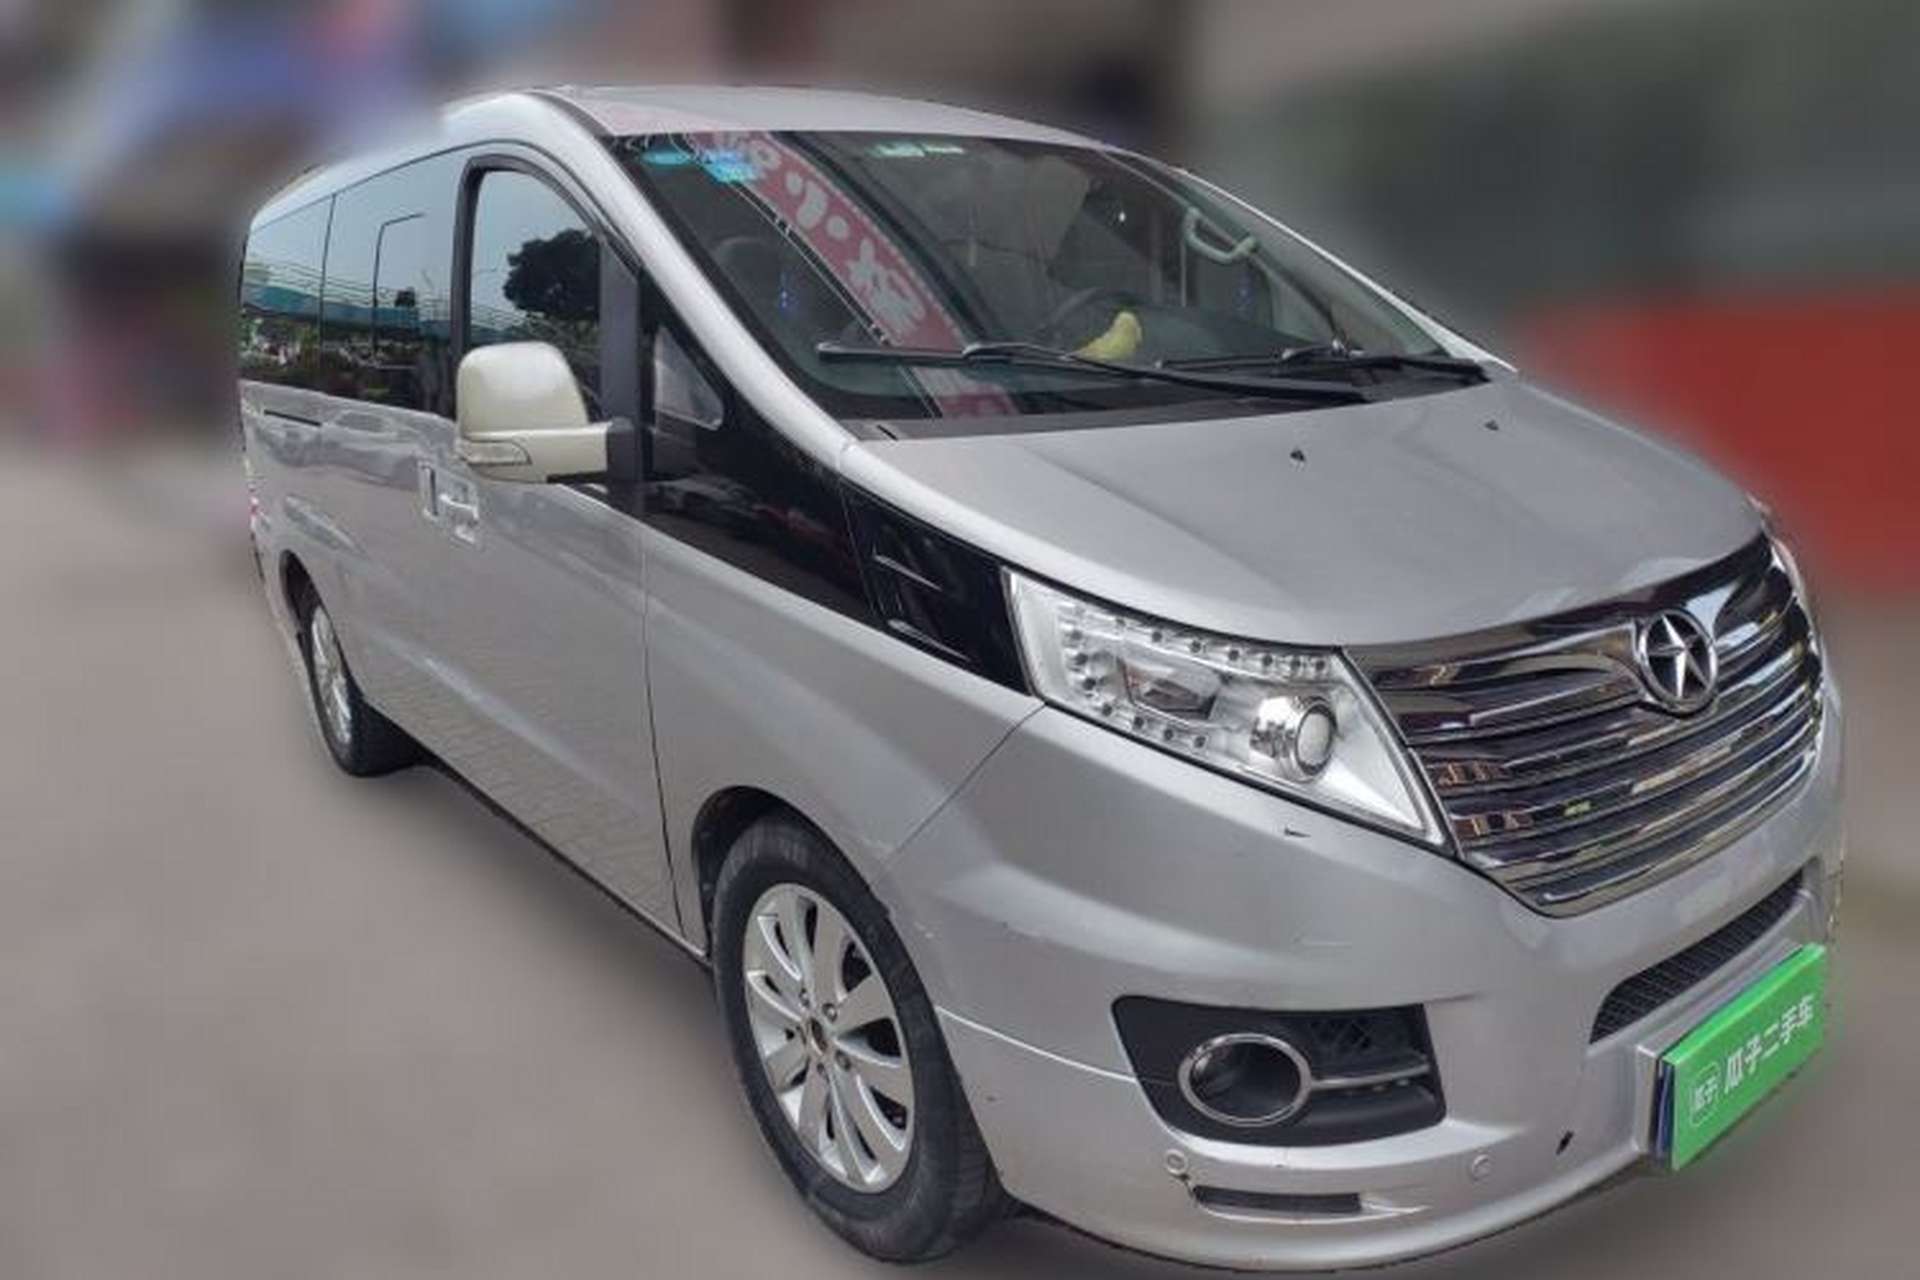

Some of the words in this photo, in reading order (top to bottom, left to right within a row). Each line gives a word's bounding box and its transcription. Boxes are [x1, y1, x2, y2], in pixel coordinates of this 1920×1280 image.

[1724, 994, 1815, 1095] 瓜子二手车
